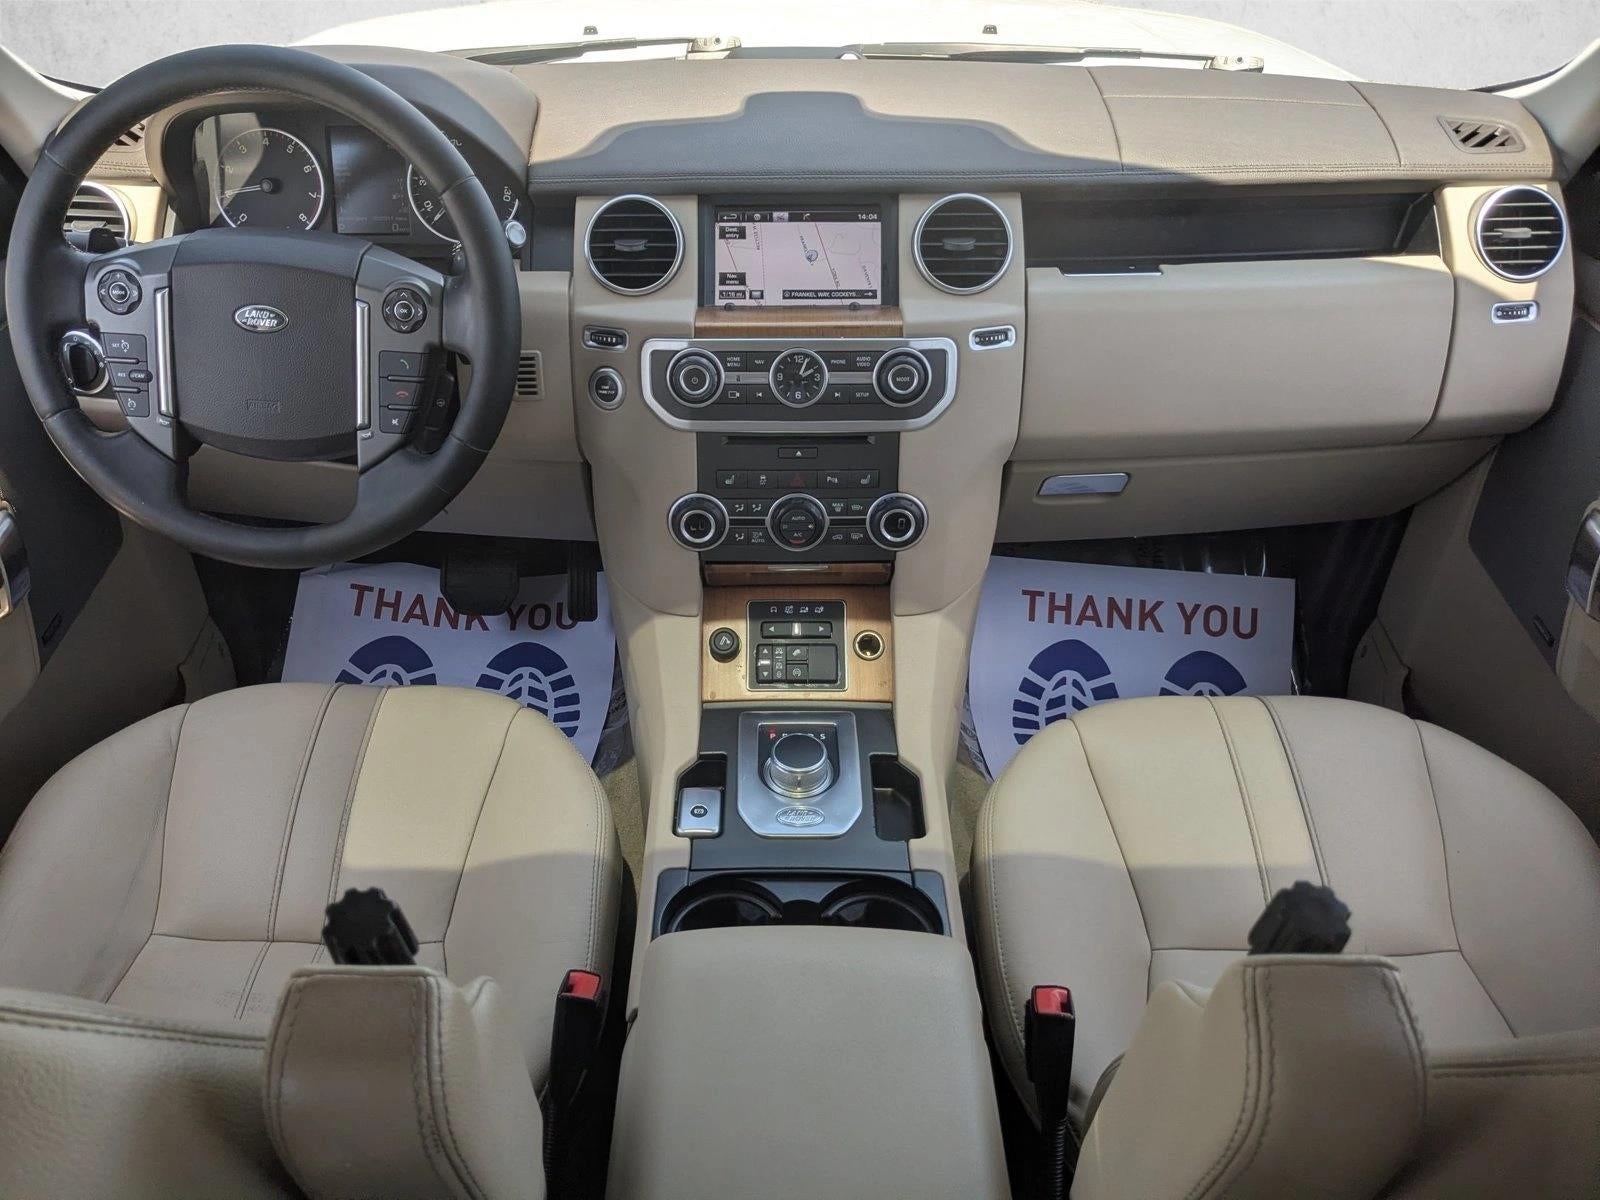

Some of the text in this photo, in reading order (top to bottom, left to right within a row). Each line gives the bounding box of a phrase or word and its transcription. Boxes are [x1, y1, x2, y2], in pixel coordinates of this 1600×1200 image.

[262, 137, 269, 146] 4
[238, 146, 248, 154] 3
[286, 146, 294, 154] 5
[225, 165, 234, 174] 2
[303, 165, 312, 174] 6
[308, 191, 317, 199] 7
[239, 213, 248, 222] 0
[298, 213, 308, 222] 8
[244, 310, 270, 318] LAND
[246, 318, 278, 327] ROVER
[794, 355, 804, 363] 12
[777, 372, 783, 381] 9
[814, 373, 820, 382] 3
[507, 602, 578, 631] YOU
[1022, 588, 1259, 640] THANK YOU
